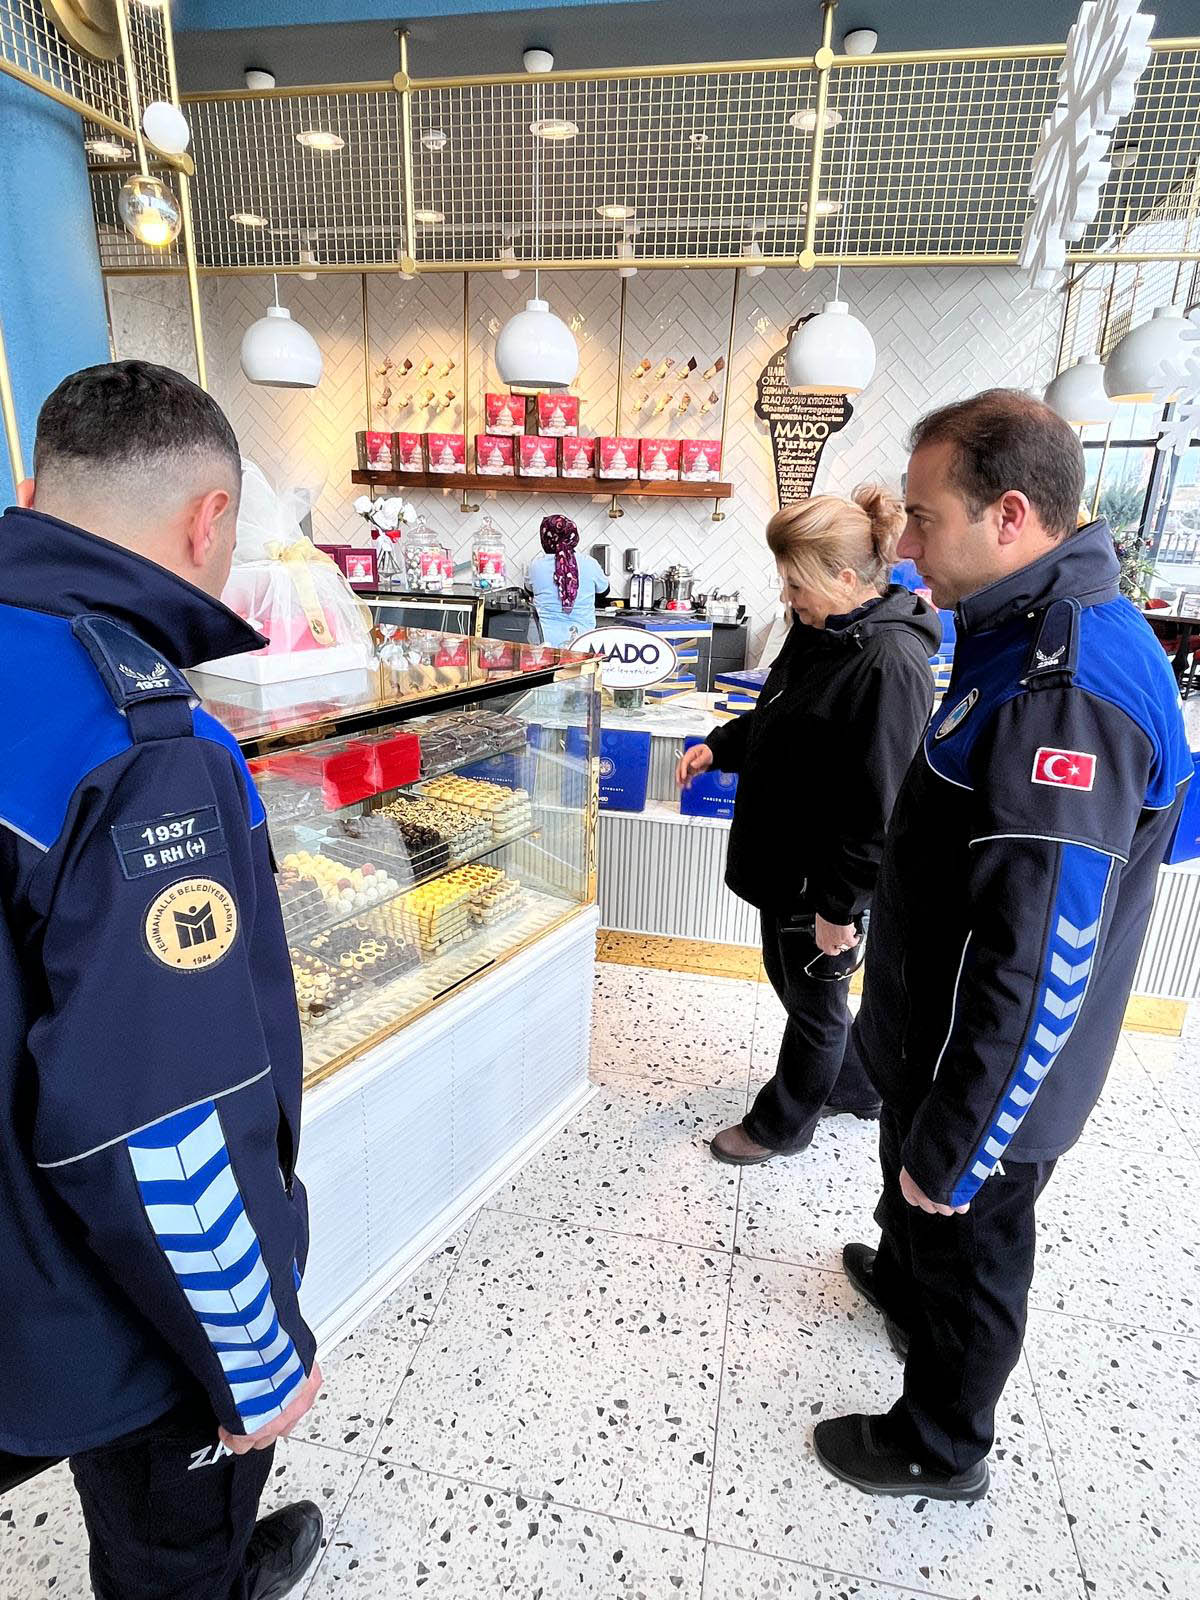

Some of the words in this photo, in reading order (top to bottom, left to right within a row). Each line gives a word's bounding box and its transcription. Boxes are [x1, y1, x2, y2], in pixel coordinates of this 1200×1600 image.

[762, 376, 789, 386] OMA
[781, 396, 807, 404] KOSOVO
[774, 421, 829, 439] MADO
[776, 438, 823, 453] Turkey
[588, 643, 660, 665] MADO
[136, 679, 172, 690] 1937
[141, 818, 196, 845] 1937
[144, 854, 157, 868] B
[160, 845, 184, 864] RH
[186, 837, 206, 858] (+)
[152, 893, 177, 954] YENİMAHALLE
[177, 884, 227, 903] BELEDİYESİ
[193, 953, 212, 965] 1984
[990, 1159, 1006, 1176] A
[187, 1439, 234, 1471] ZA
